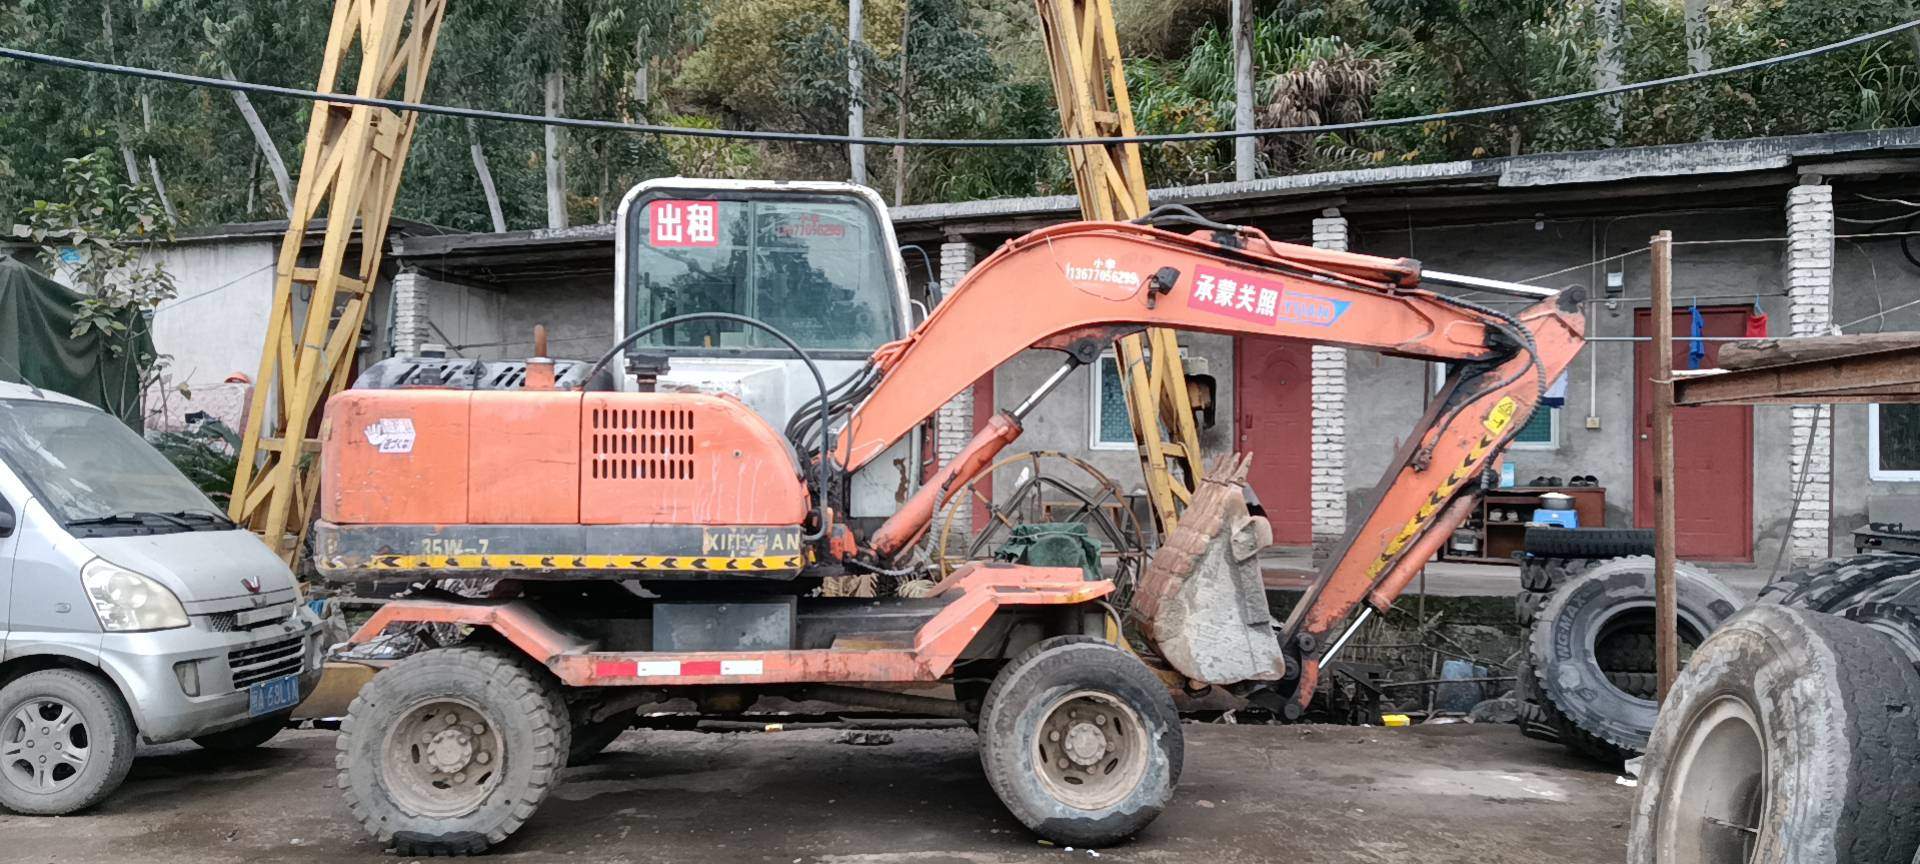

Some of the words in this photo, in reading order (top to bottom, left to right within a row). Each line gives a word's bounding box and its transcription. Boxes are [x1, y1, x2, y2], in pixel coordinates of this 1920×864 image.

[657, 203, 715, 242] 出租
[1193, 273, 1279, 317] 承蒙关照
